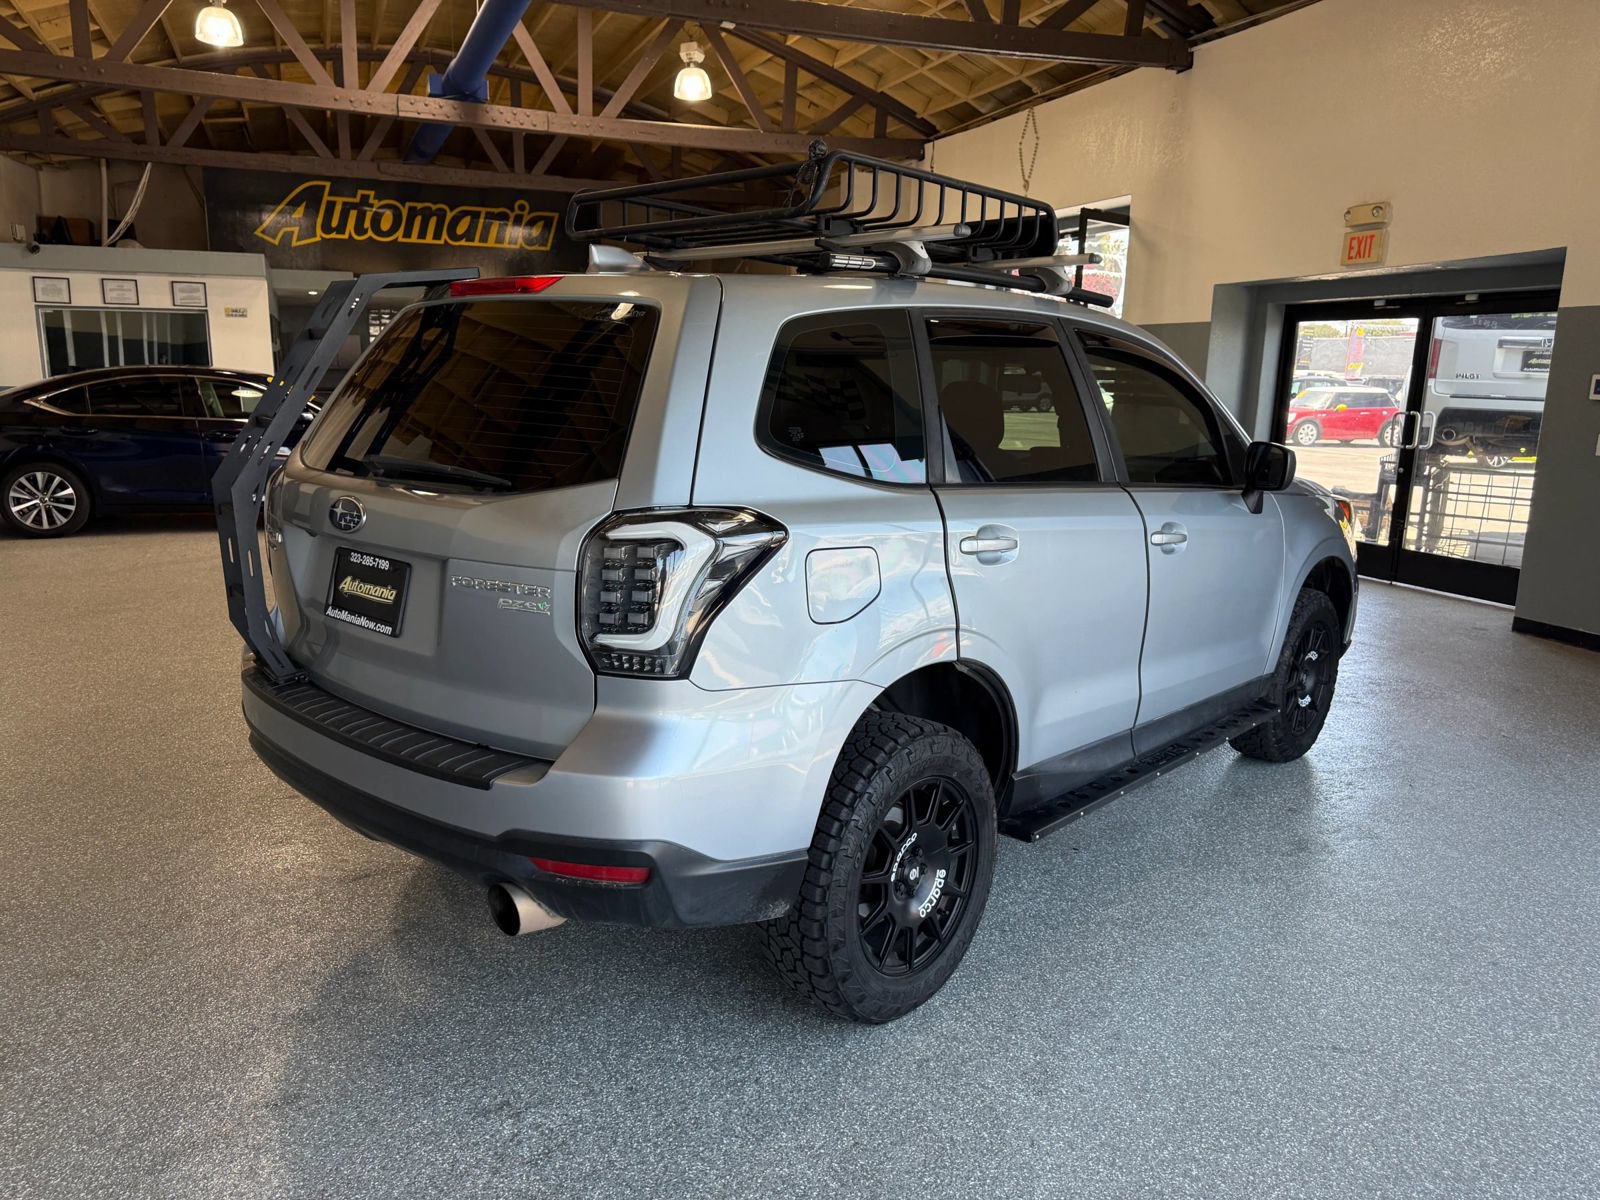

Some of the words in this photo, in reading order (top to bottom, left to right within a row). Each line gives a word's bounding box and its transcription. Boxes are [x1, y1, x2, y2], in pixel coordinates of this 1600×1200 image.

[254, 180, 559, 251] Automania
[1347, 234, 1375, 260] EXIT
[350, 552, 390, 571] 323-285-7199
[339, 575, 397, 601] Automania
[451, 575, 551, 599] FORESTER
[325, 605, 392, 635] AutoManiaNow.com
[918, 869, 946, 918] sparco
